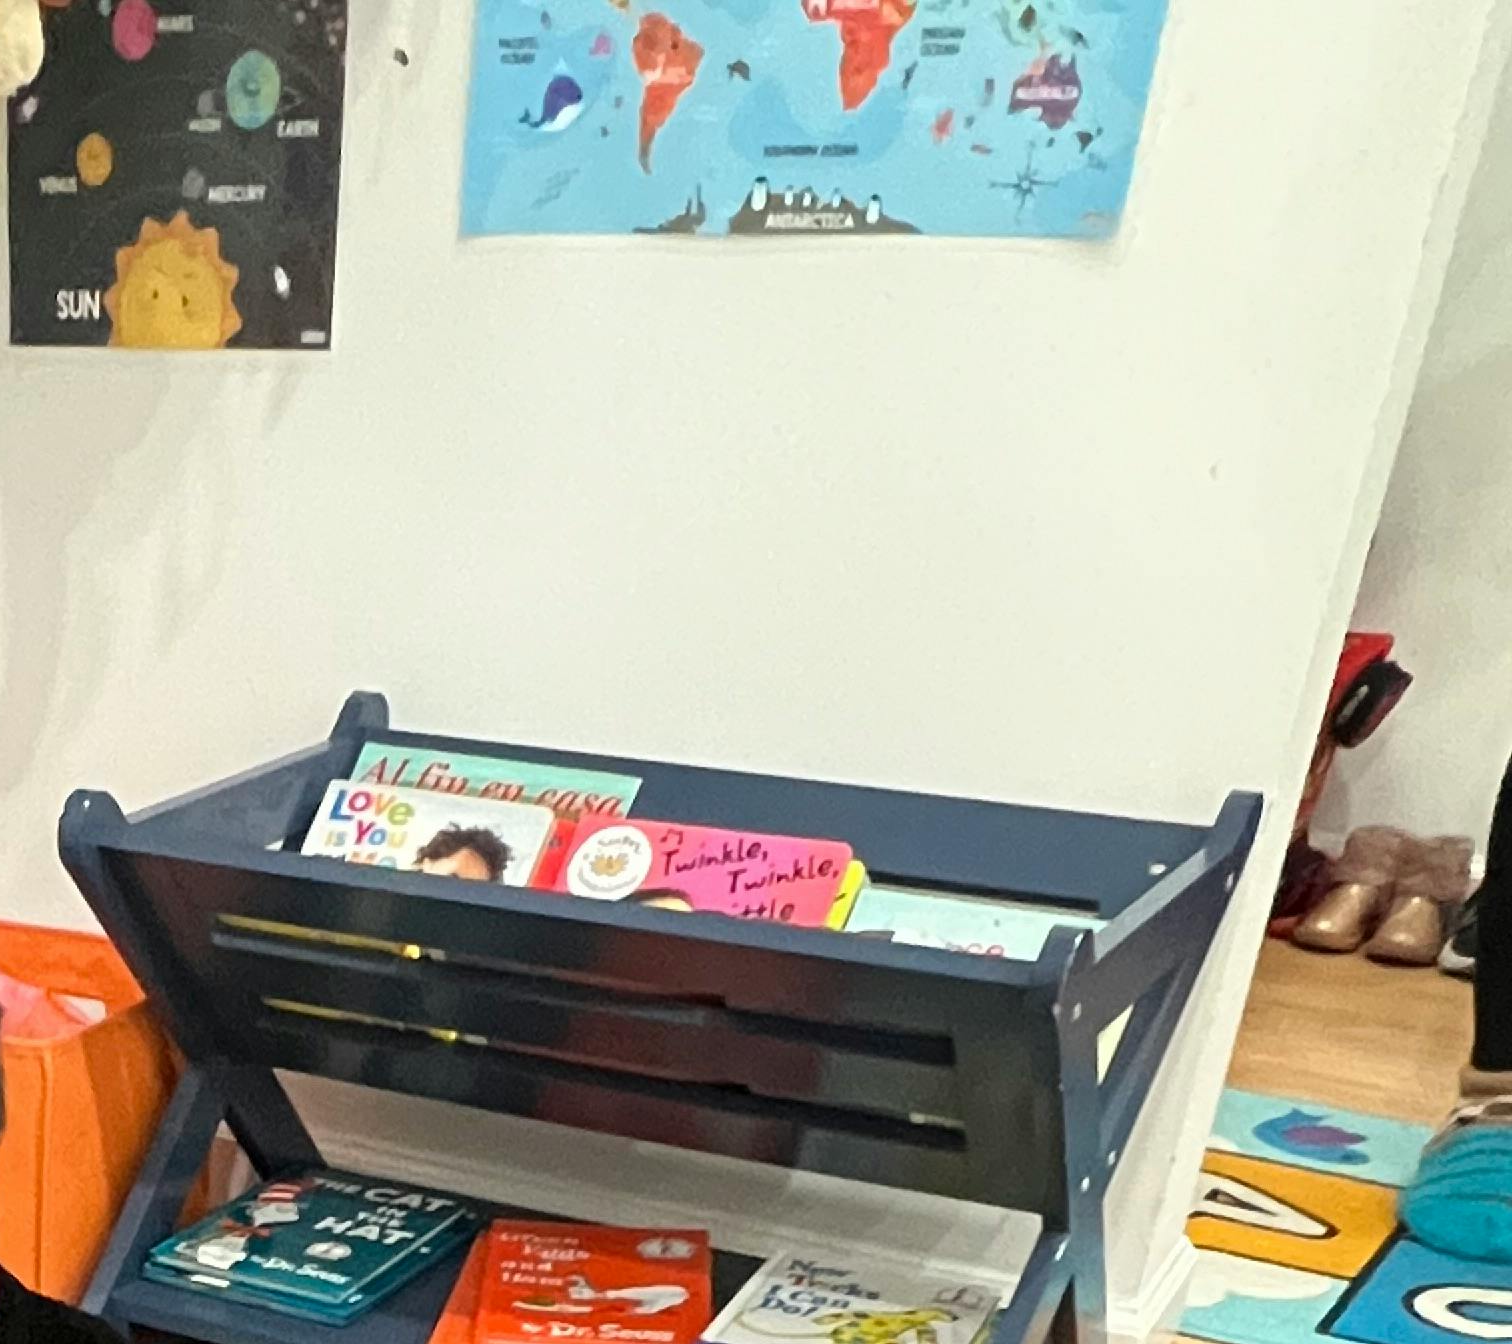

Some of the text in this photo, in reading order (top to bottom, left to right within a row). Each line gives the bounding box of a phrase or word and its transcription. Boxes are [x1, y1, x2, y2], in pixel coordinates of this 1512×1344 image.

[55, 289, 101, 321] SUN
[414, 761, 470, 795] fin
[660, 838, 769, 877] Twinkle,
[726, 857, 840, 895] Twinkle,
[363, 1187, 458, 1213] CAT
[312, 1215, 417, 1245] HAT
